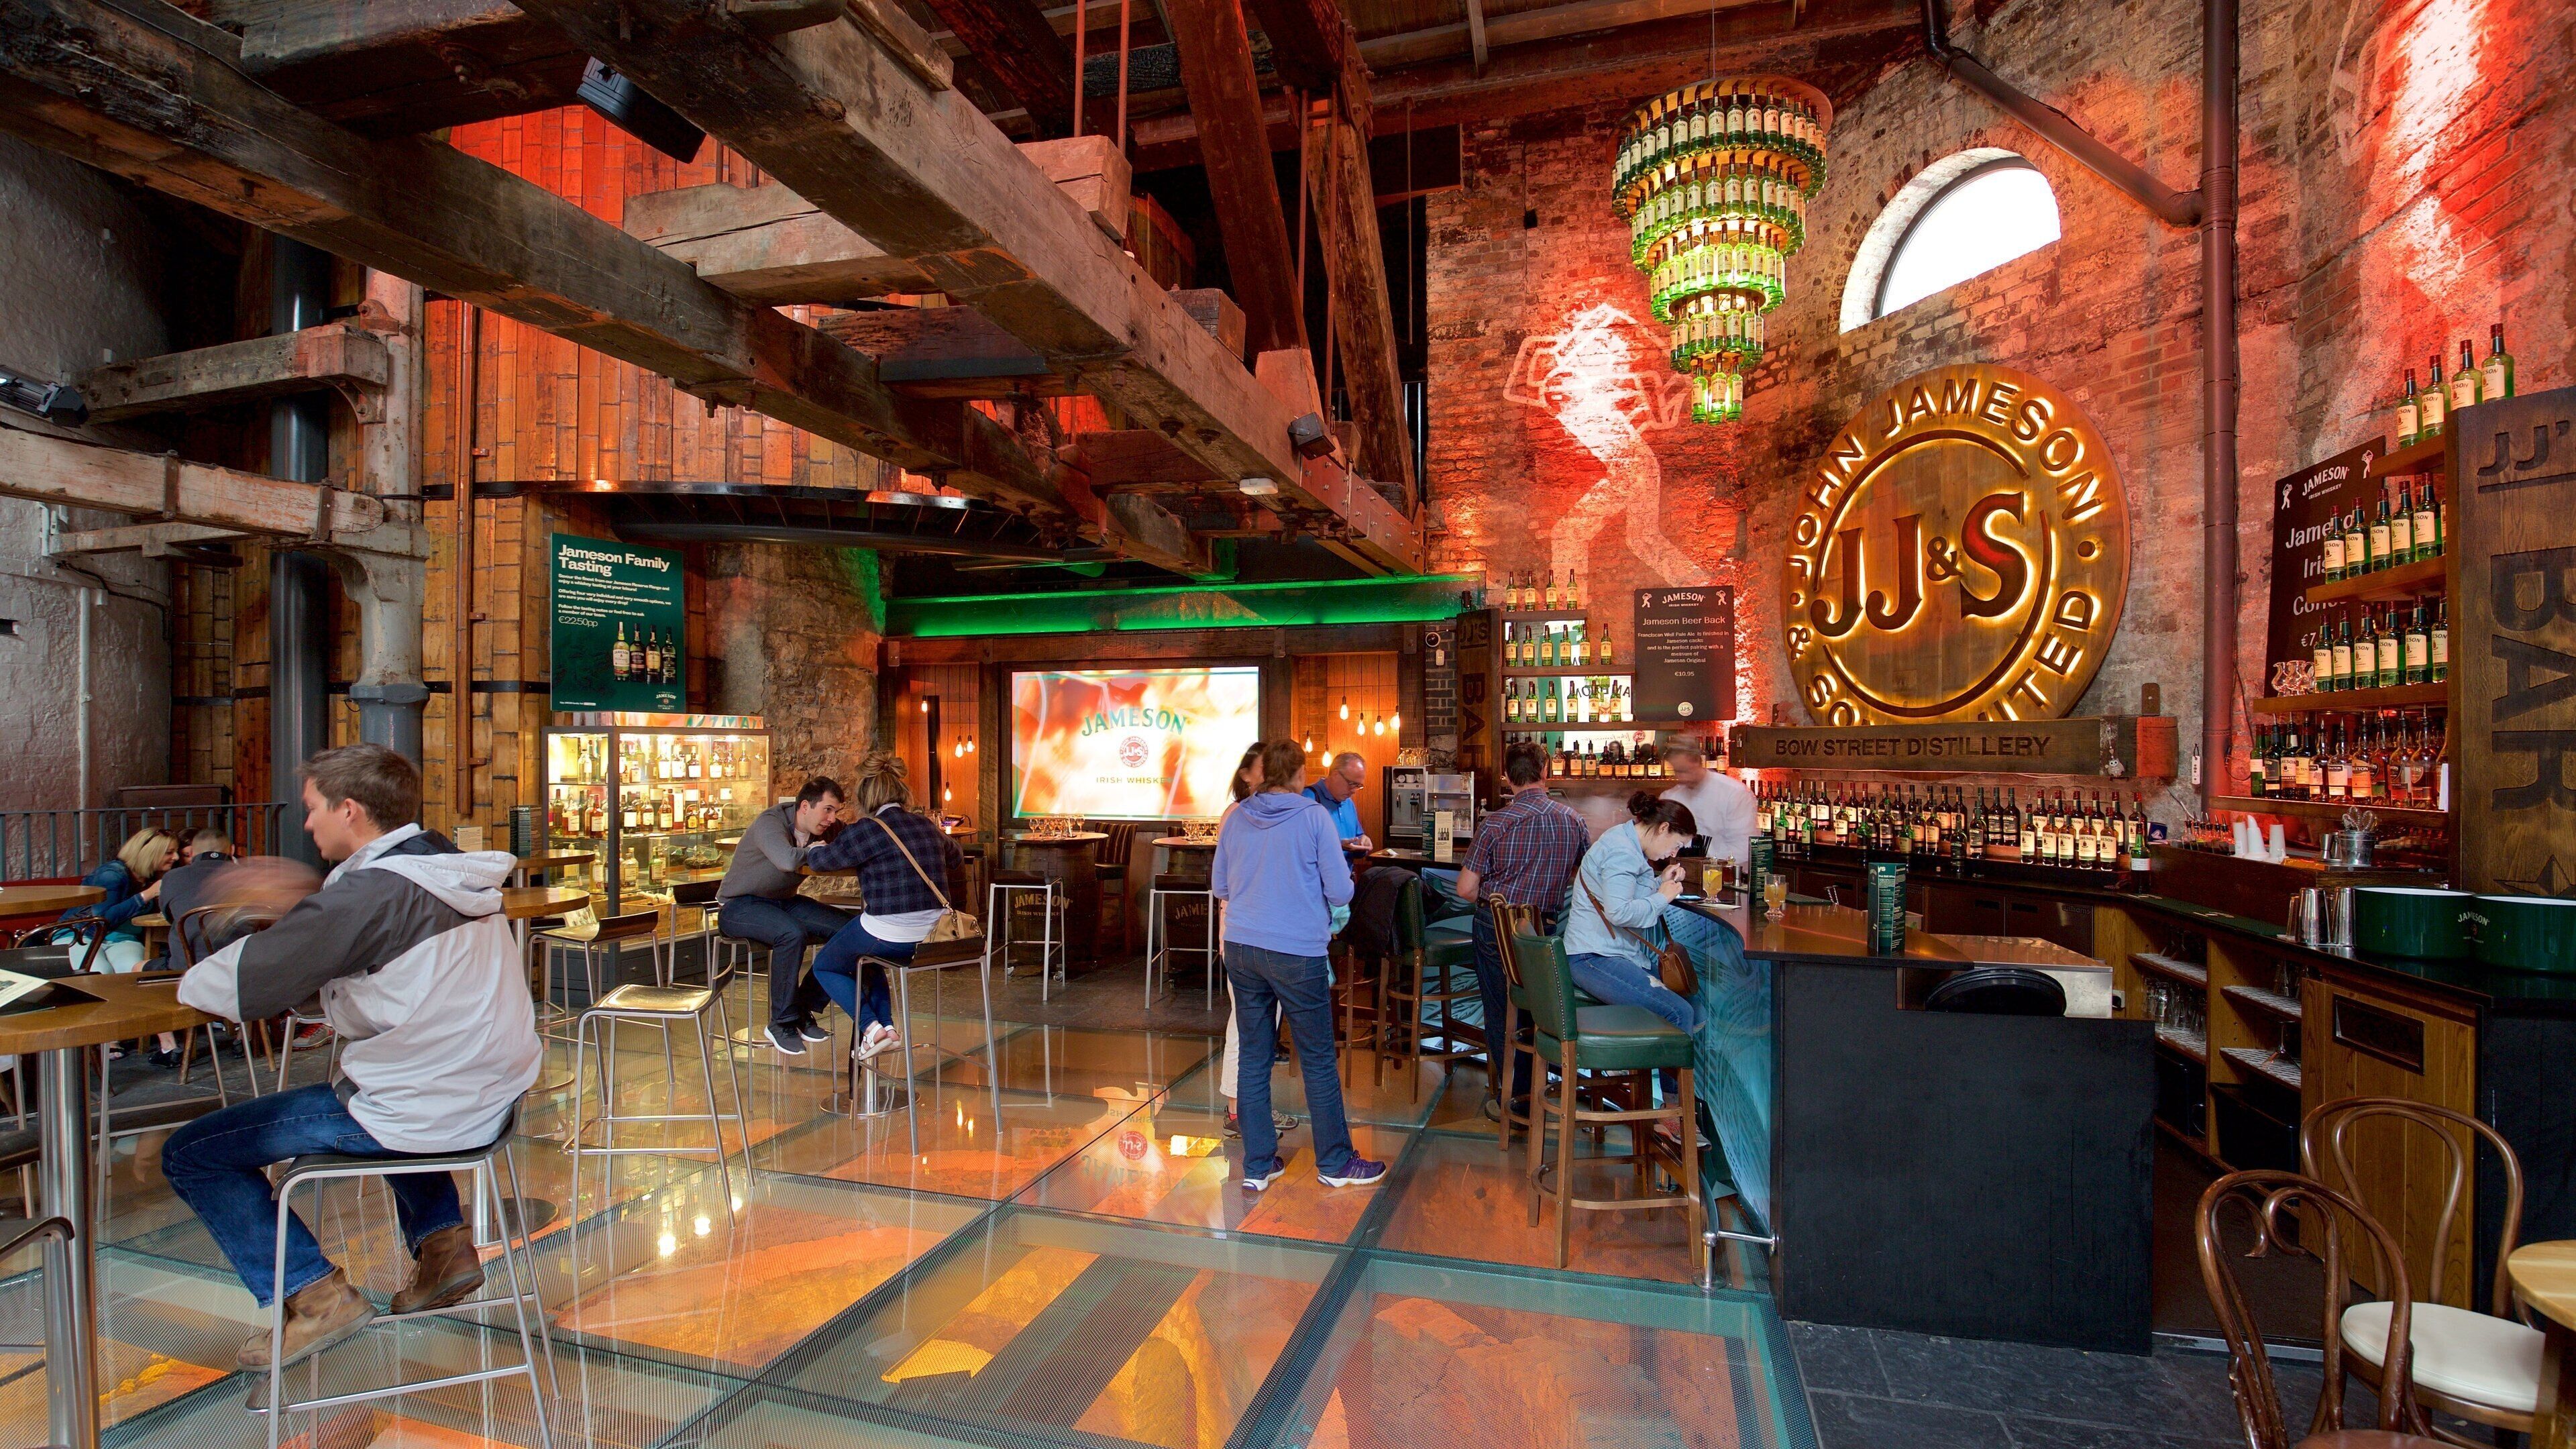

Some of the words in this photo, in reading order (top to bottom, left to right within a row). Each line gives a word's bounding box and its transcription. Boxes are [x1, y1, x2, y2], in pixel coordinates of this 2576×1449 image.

[1786, 434, 1866, 578] JOHN
[1880, 378, 2101, 521] JAMESON
[2302, 466, 2349, 496] JAMESON
[2308, 490, 2321, 500] IRISH
[2321, 483, 2343, 496] WHISKEY
[558, 544, 623, 564] Jameson
[625, 553, 670, 572] Family
[558, 556, 612, 577] Tasting
[1811, 491, 2028, 637] JJ&S
[1662, 592, 1705, 604] JAMESON
[1642, 618, 1680, 626] Jameson
[1682, 617, 1702, 625] Beer
[1704, 616, 1726, 625] Back
[1081, 708, 1187, 737] JAMESON
[1775, 739, 1819, 756] BOW
[1824, 738, 1902, 756] STREET
[1907, 737, 2051, 757] DISTILLERY
